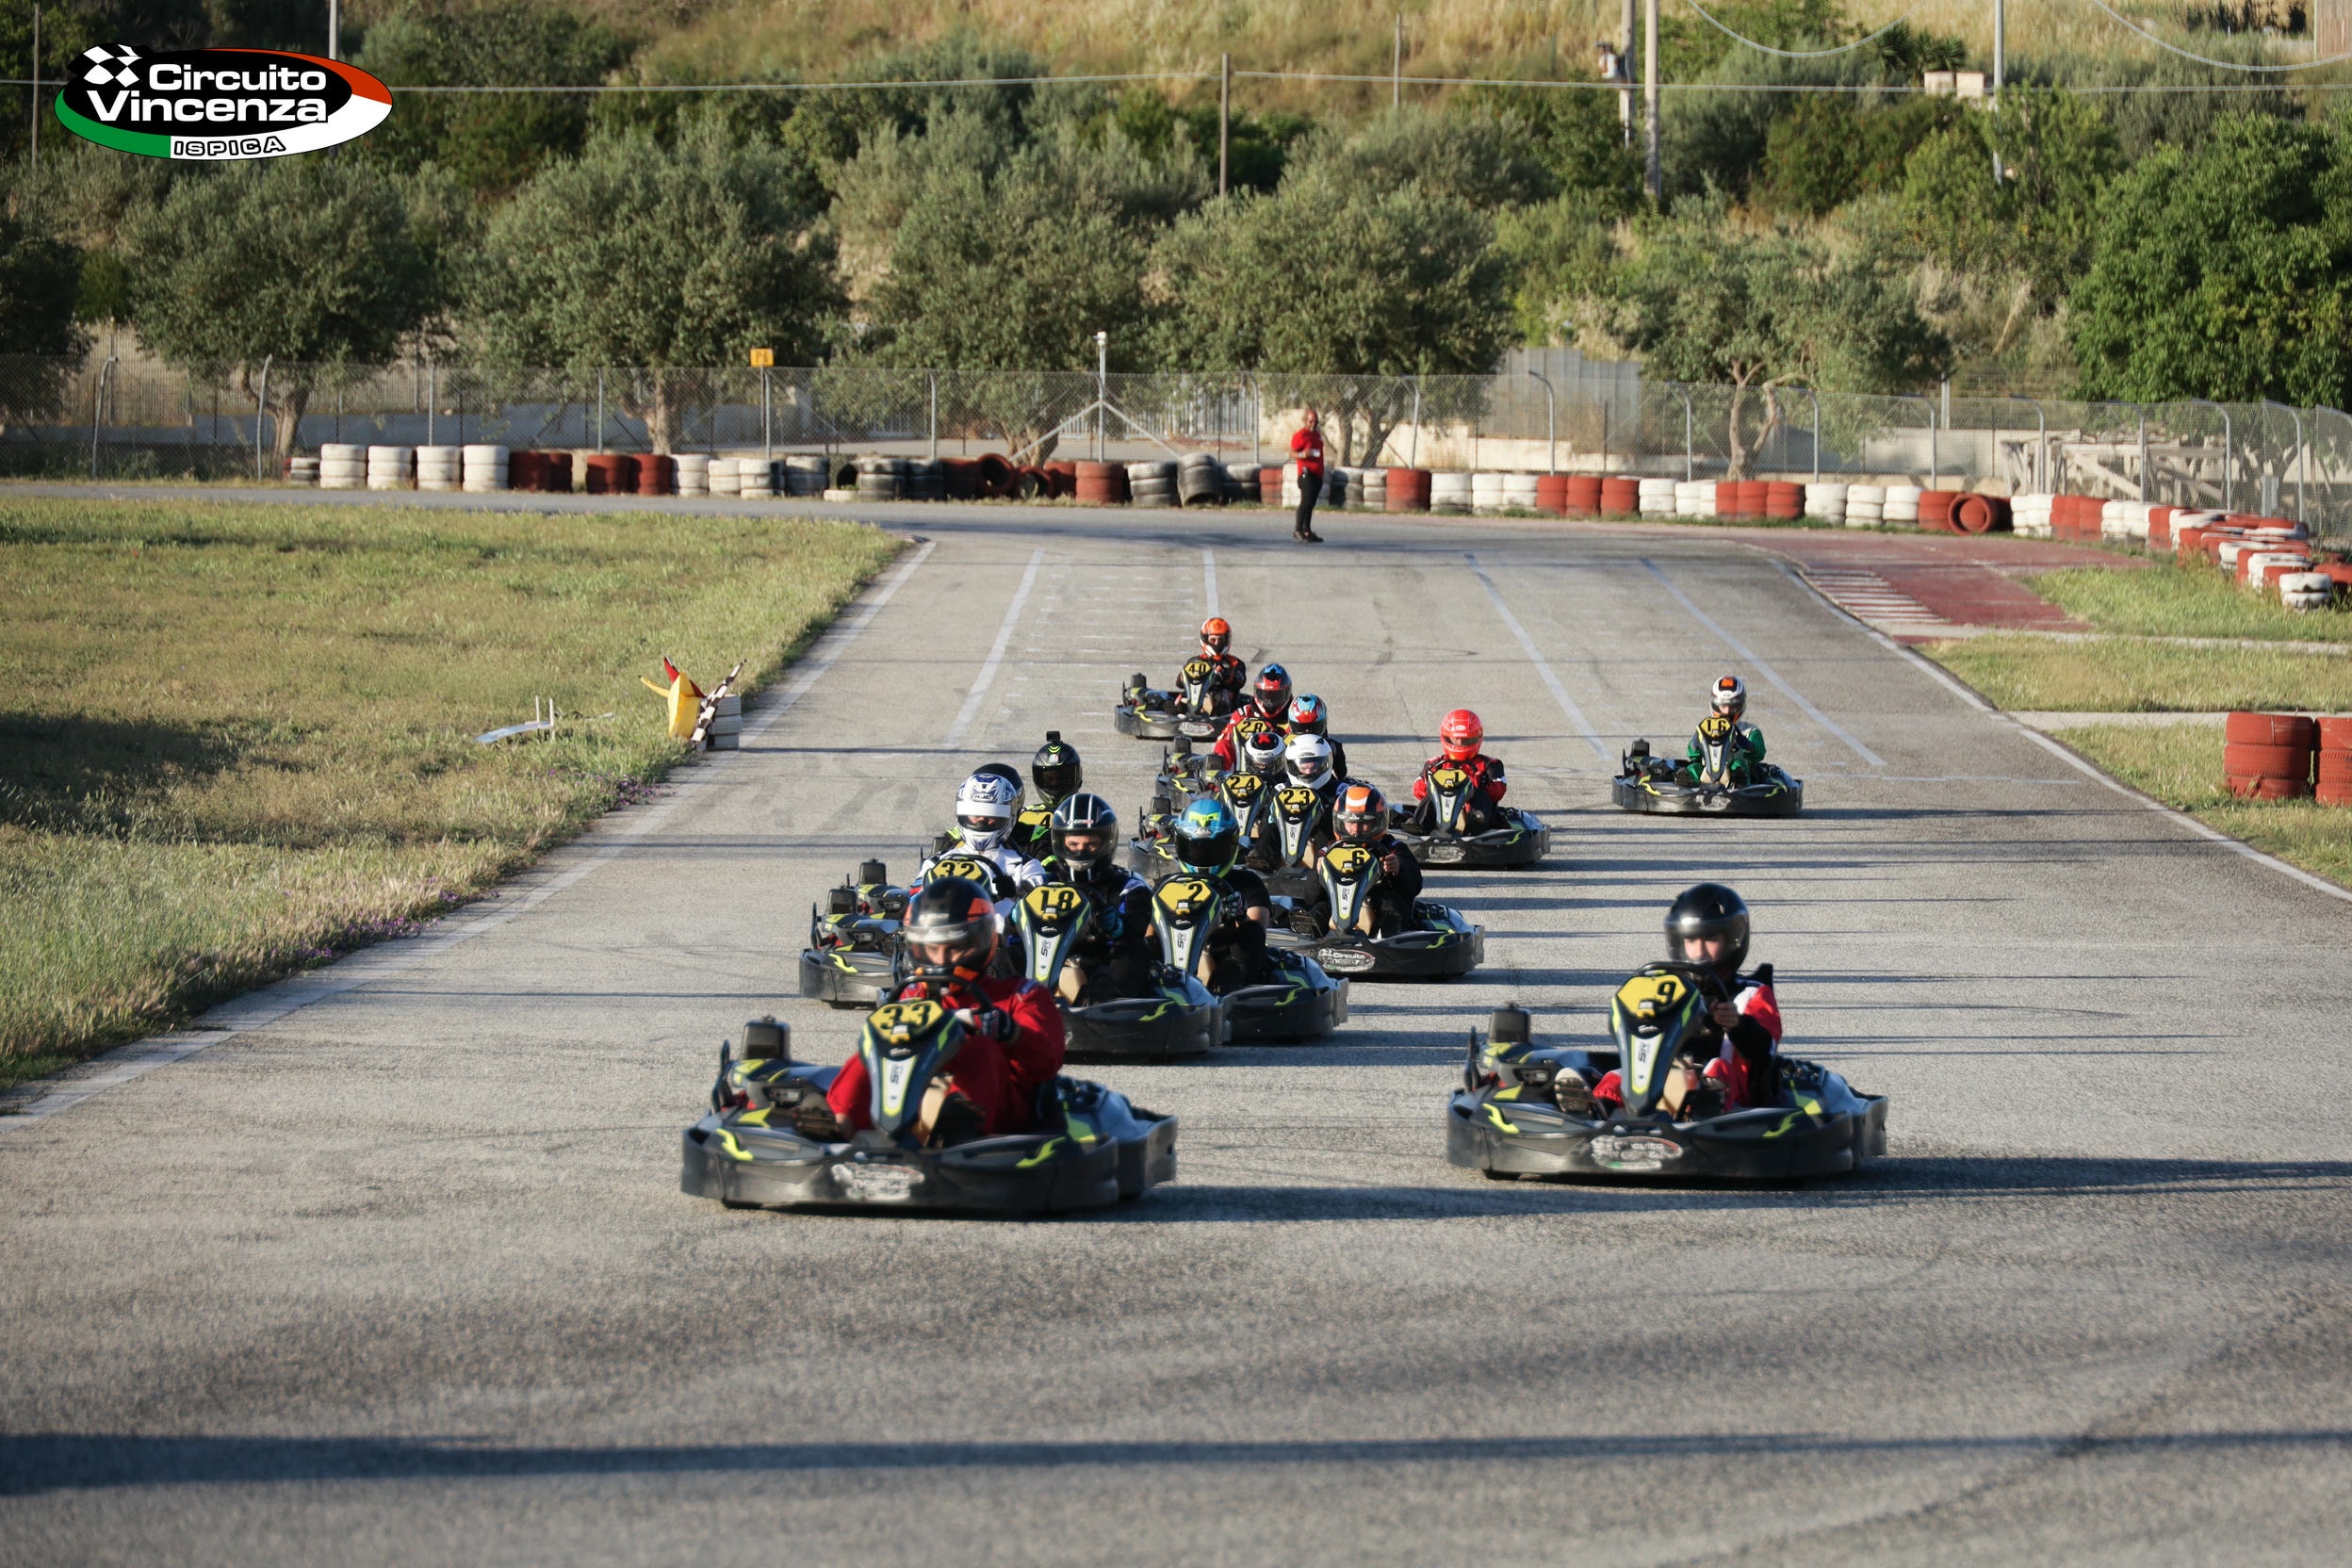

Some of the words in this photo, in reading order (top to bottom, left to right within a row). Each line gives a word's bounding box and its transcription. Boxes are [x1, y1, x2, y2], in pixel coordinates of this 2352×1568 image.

[1230, 776, 1255, 792] 24
[1283, 790, 1310, 807] 23
[1039, 813, 1051, 828] 4
[1351, 850, 1364, 866] 6
[1040, 890, 1074, 911] 18
[1187, 883, 1203, 902] 2
[1657, 981, 1676, 1007] 9
[880, 1004, 931, 1030] 33
